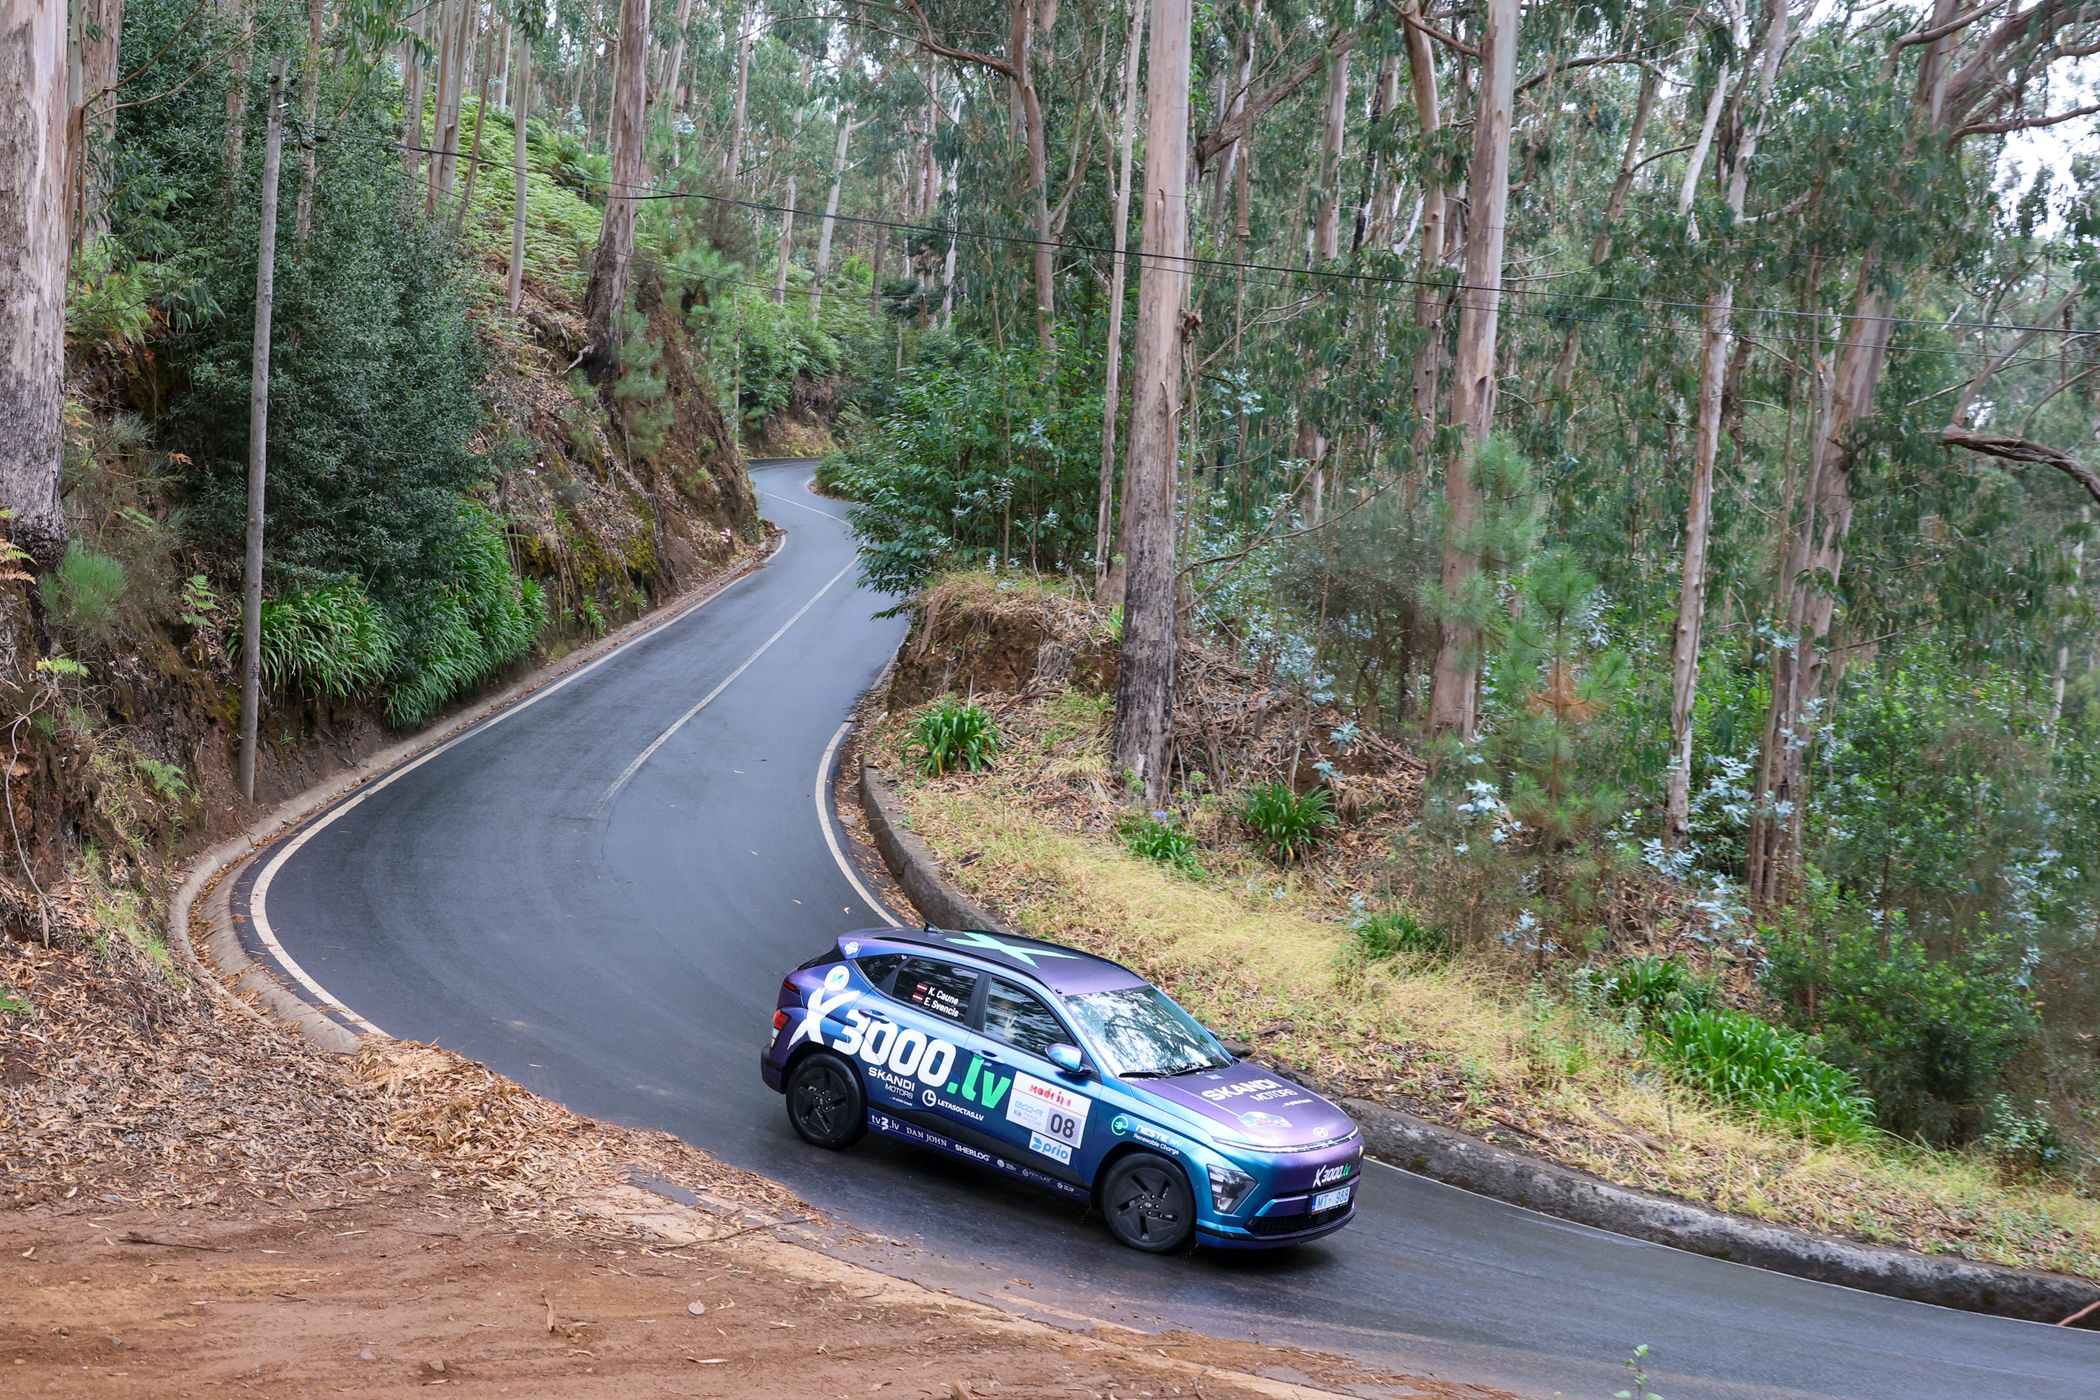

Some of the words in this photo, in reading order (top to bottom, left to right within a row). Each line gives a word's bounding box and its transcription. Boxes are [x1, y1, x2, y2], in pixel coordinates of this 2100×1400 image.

[923, 996, 932, 1007] E.
[928, 986, 937, 997] K.
[936, 990, 959, 1005] Caune
[868, 1066, 916, 1092] SKANDI
[884, 1083, 914, 1100] MOTORS
[1201, 1079, 1284, 1101] SKANDI
[1249, 1088, 1299, 1102] MOTORS
[937, 1098, 985, 1121] LETASOCTAS.LV
[1050, 1113, 1076, 1139] 08
[906, 1126, 924, 1139] DAN
[926, 1133, 948, 1148] JOHN
[1133, 1132, 1160, 1149] Renewable
[1160, 1143, 1180, 1156] Charge
[954, 1143, 990, 1162] SHERLOG
[1042, 1142, 1069, 1160] prio
